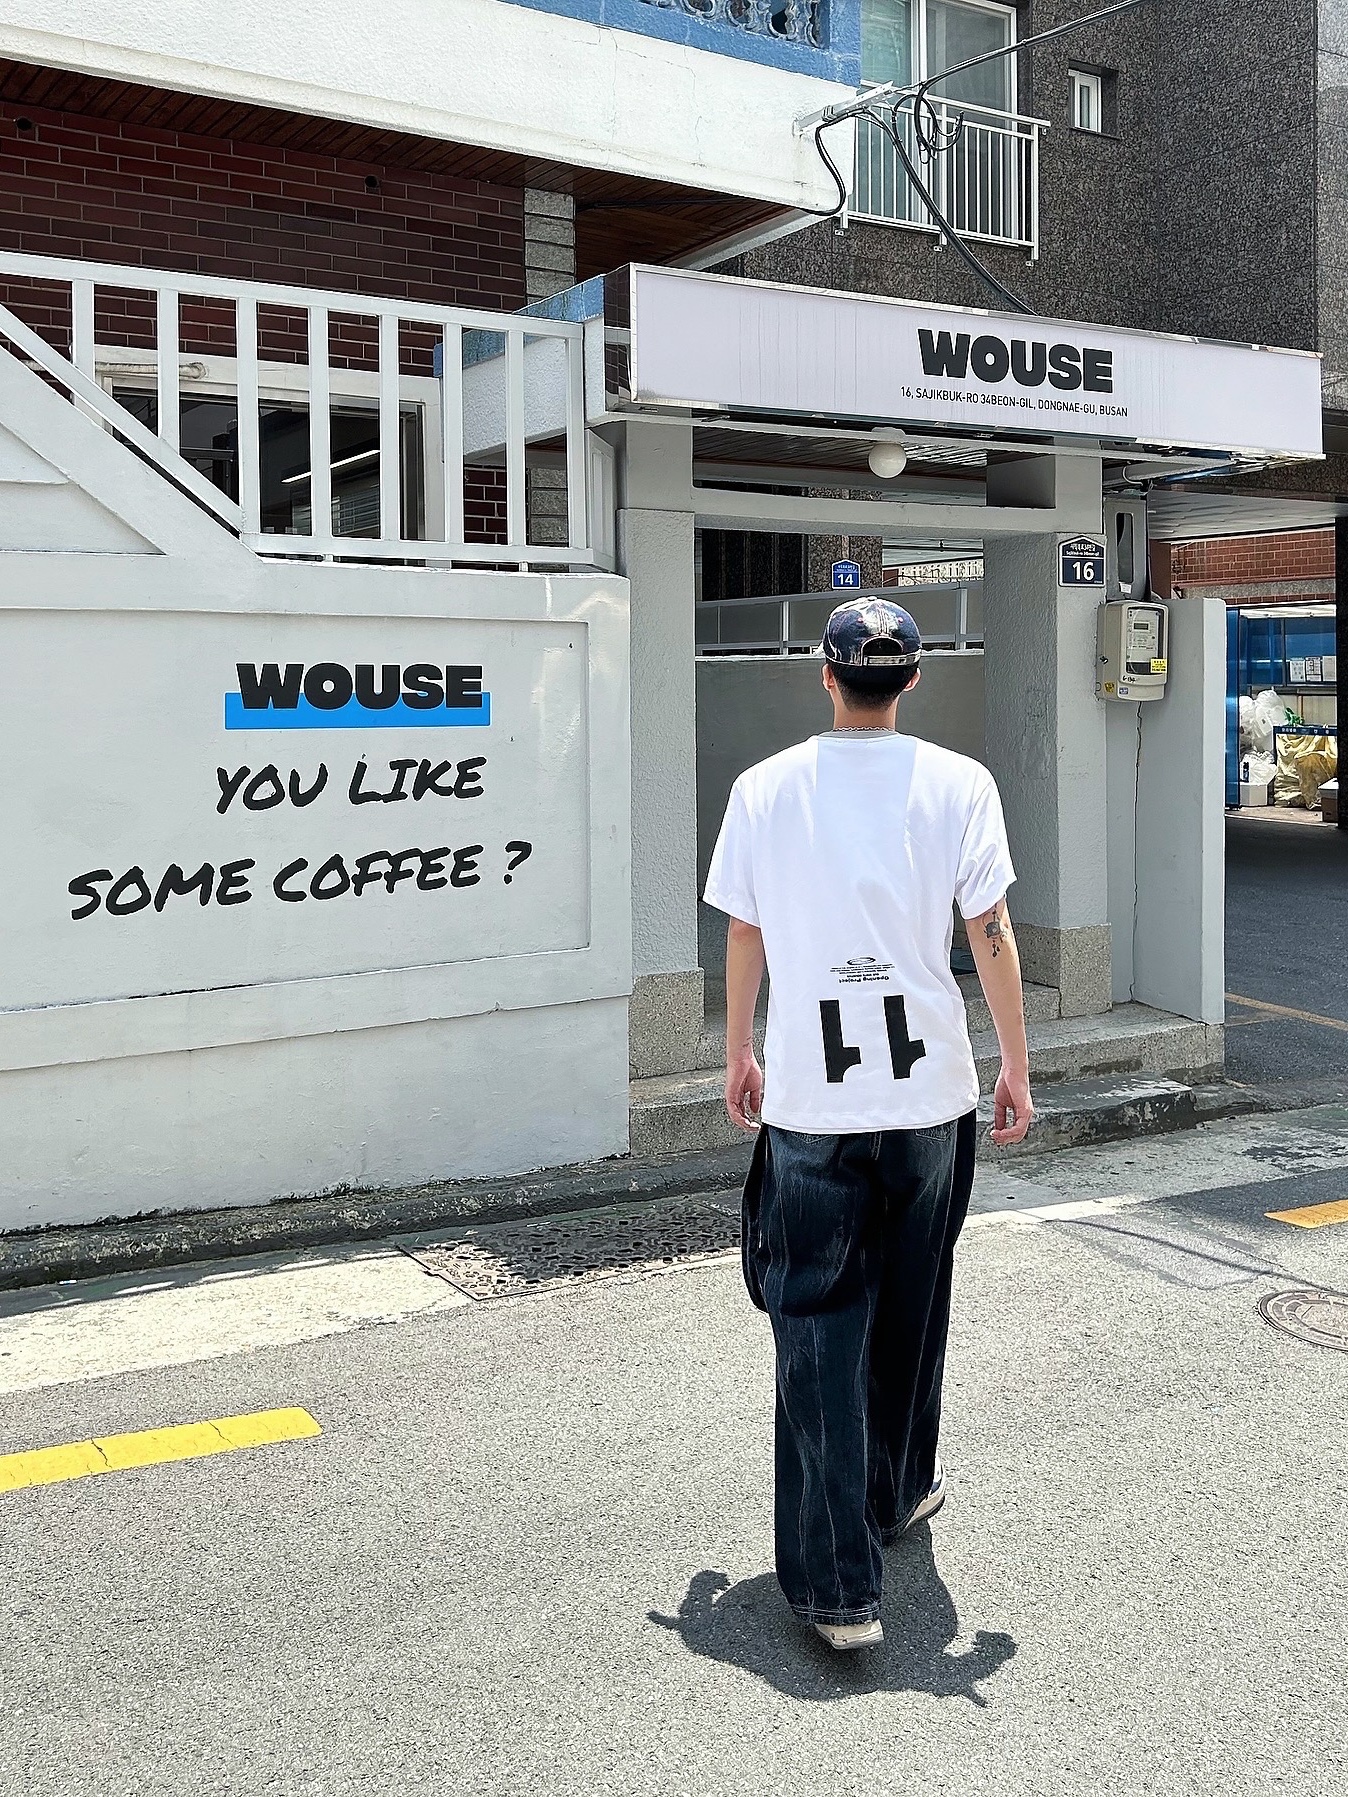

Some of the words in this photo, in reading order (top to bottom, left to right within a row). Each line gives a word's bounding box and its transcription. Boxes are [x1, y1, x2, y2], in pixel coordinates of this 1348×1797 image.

[917, 328, 1113, 393] WOUSE
[900, 386, 914, 399] 16,
[915, 387, 979, 404] SAJIKBUK-RO
[980, 393, 1036, 410] 34BEON-GIL,
[1038, 398, 1098, 416] DONGNAE-GU,
[1099, 405, 1128, 417] BUSAN
[837, 573, 854, 585] 14
[1072, 561, 1095, 581] 16
[236, 663, 482, 709] WOUSE
[217, 762, 328, 814] YOU
[349, 756, 486, 805] LIKE
[68, 858, 255, 920] SOME
[273, 844, 483, 902] COFFEE
[503, 841, 532, 884] ?
[819, 994, 926, 1083] 11
